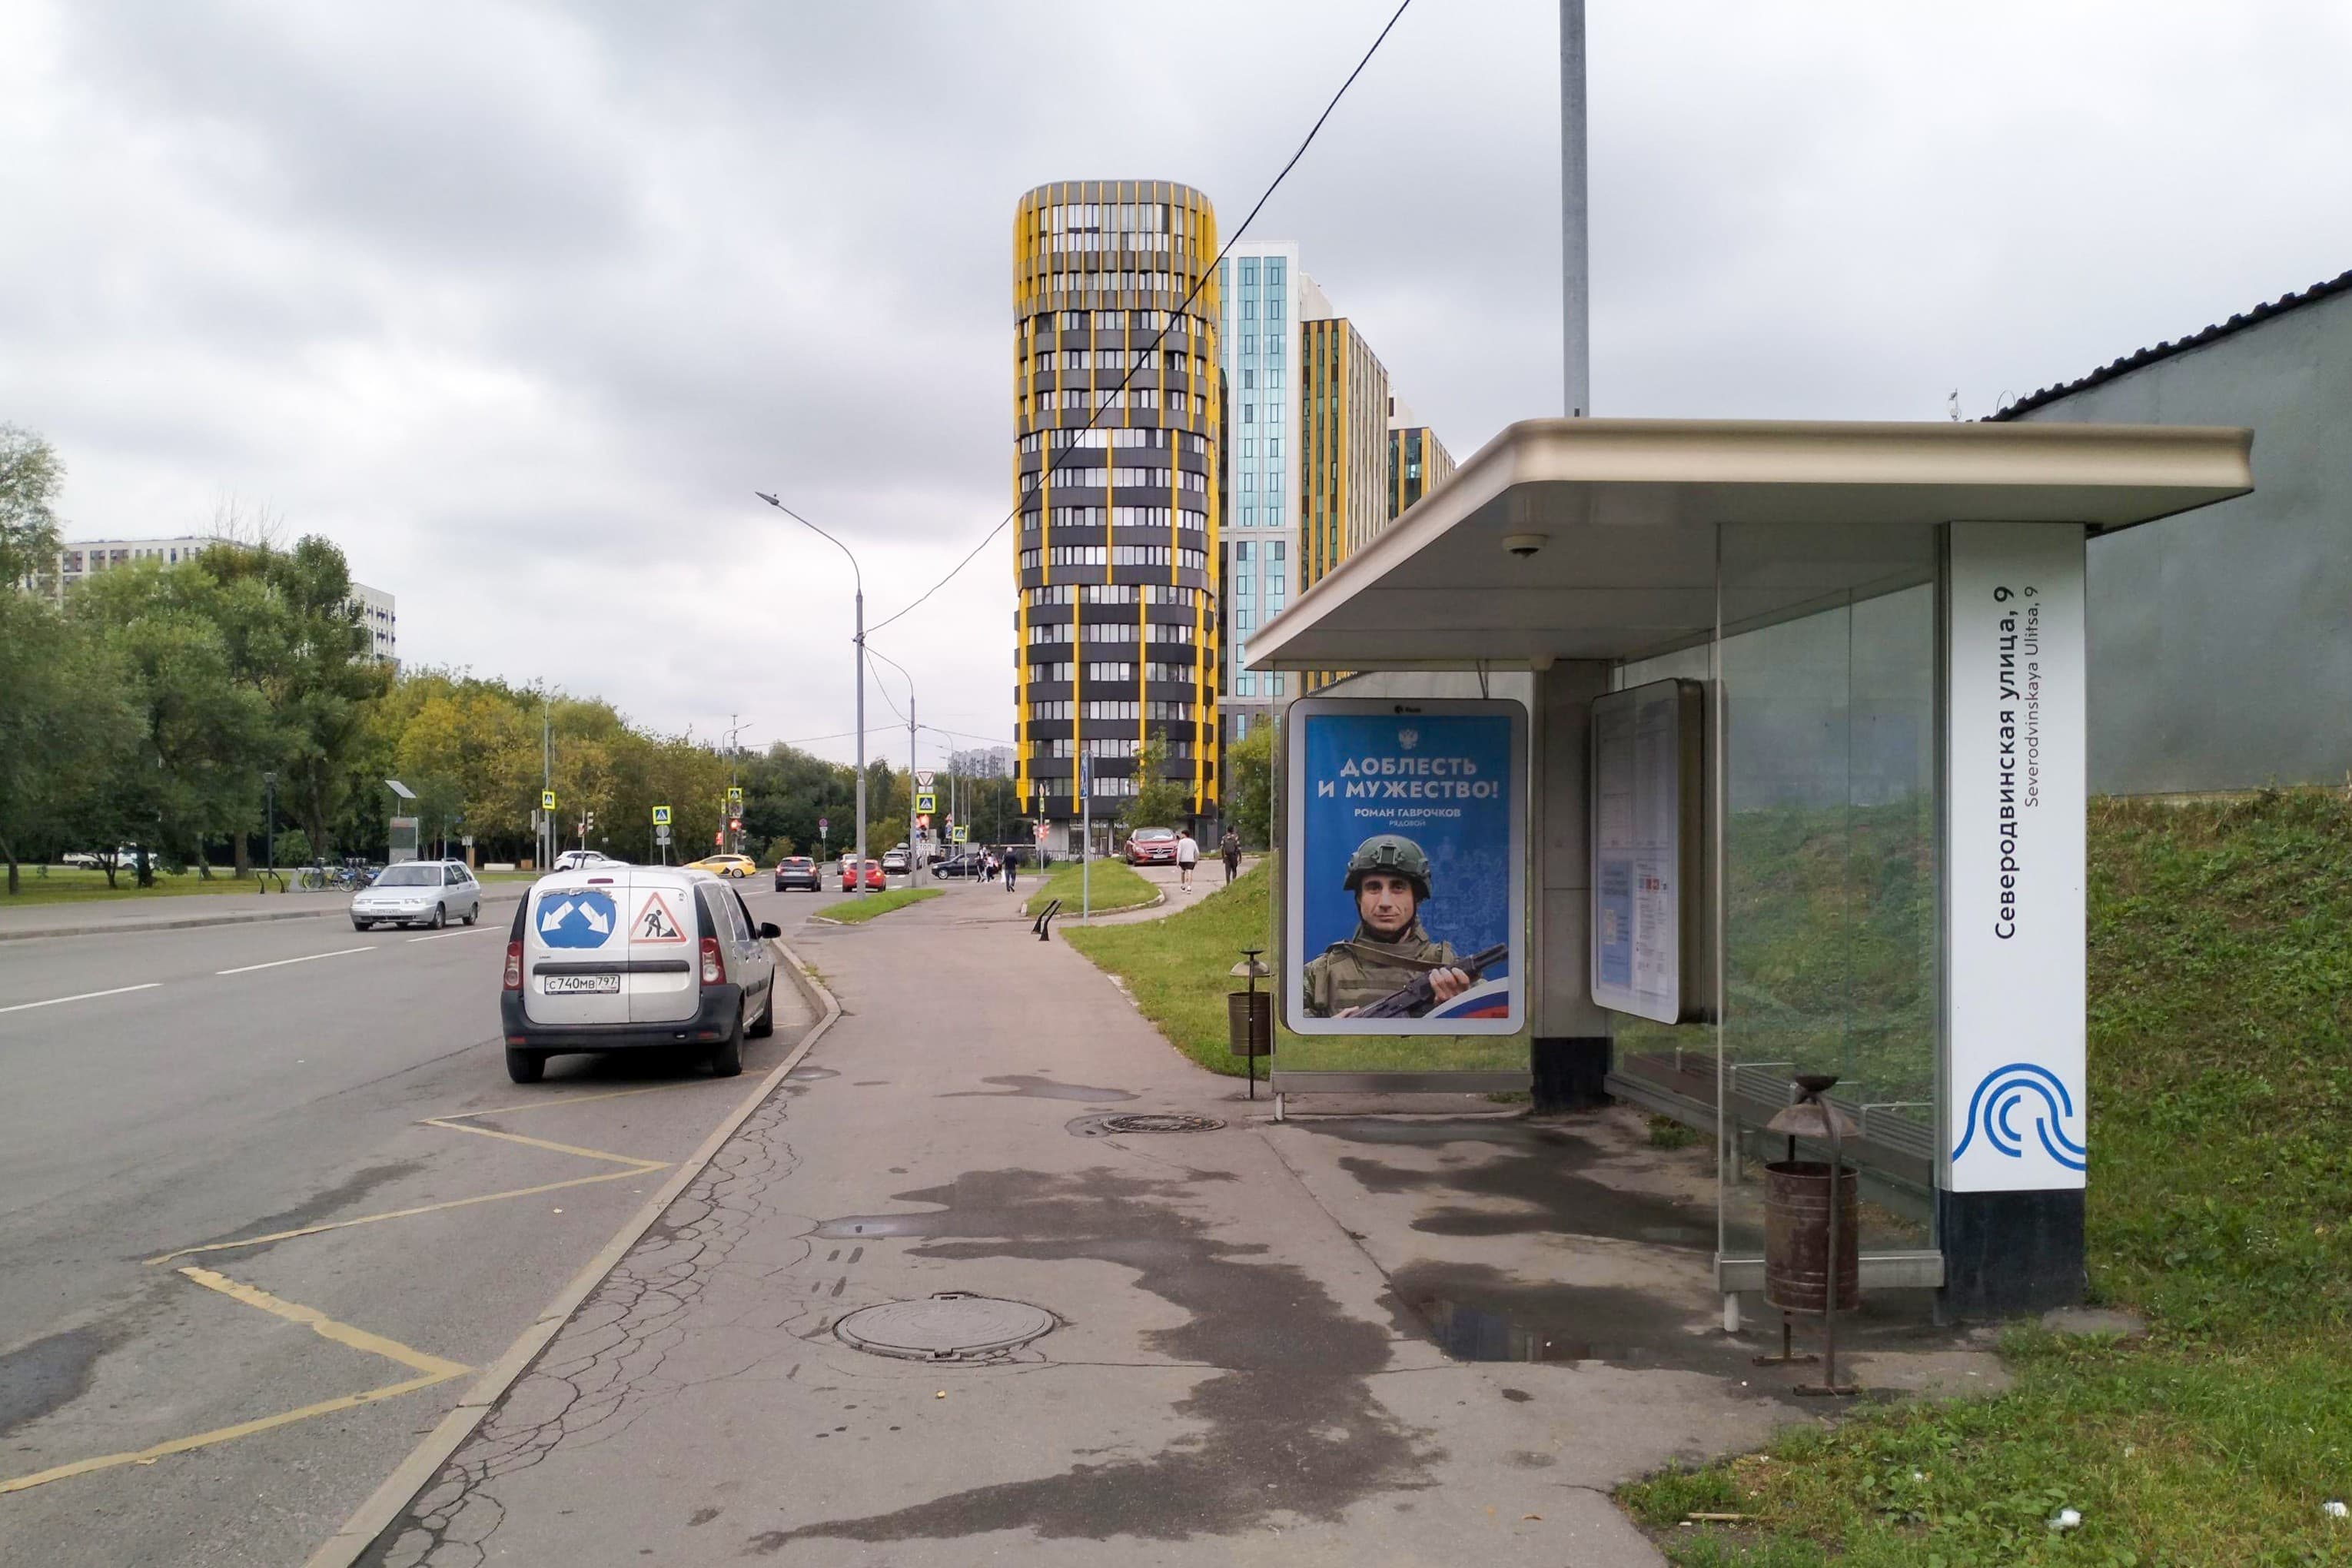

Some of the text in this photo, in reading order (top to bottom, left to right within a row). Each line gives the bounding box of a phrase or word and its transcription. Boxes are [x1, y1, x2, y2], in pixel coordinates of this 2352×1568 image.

[2024, 586, 2041, 808] Severodvinskaya Ulitsa, 9
[1340, 757, 1478, 778] ДОБЛЕСТЬ
[1994, 586, 2020, 939] Северодвинская улица, 9
[1317, 780, 1500, 799] И МУЖЕСТВО!
[1354, 808, 1461, 818] РОМАН ГАВРОЧКОВ
[1389, 819, 1427, 828] РЯДОВОЙ
